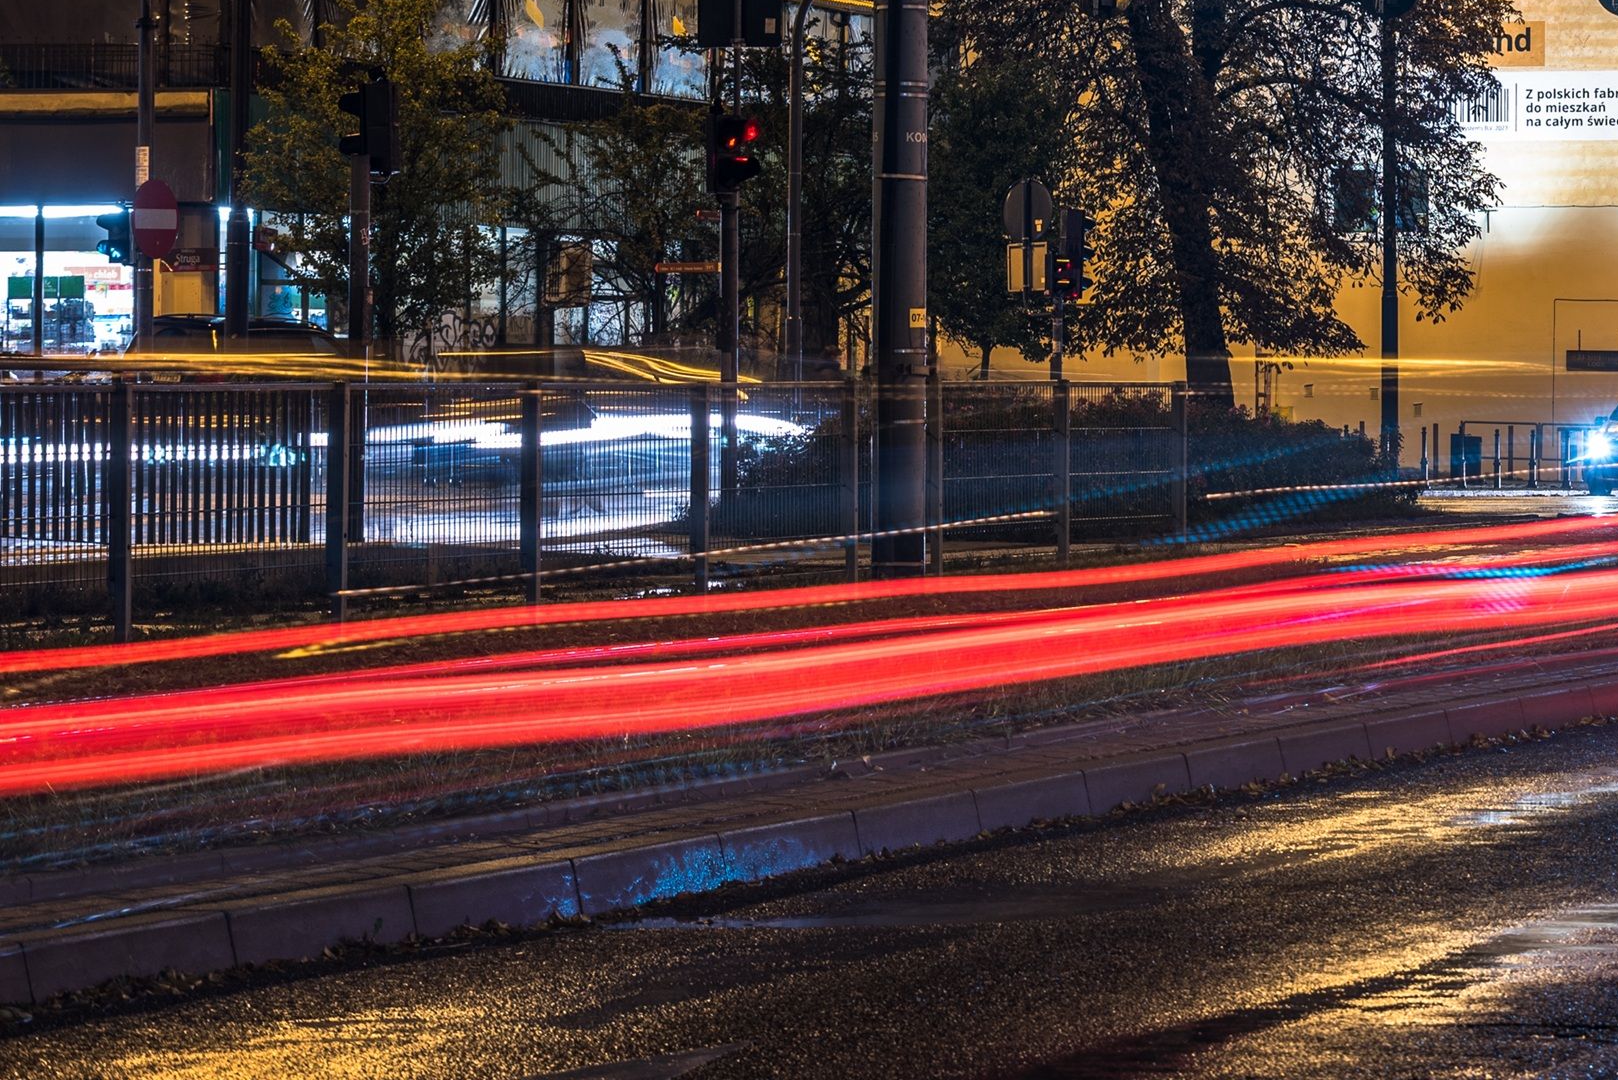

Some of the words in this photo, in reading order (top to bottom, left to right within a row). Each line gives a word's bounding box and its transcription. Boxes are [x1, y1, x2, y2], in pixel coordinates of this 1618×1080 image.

[1525, 88, 1533, 99] Z
[1537, 88, 1590, 102] polskich
[1525, 102, 1541, 113] do
[1545, 101, 1606, 113] mieszkań
[1525, 118, 1541, 127] na
[1545, 115, 1583, 129] całym
